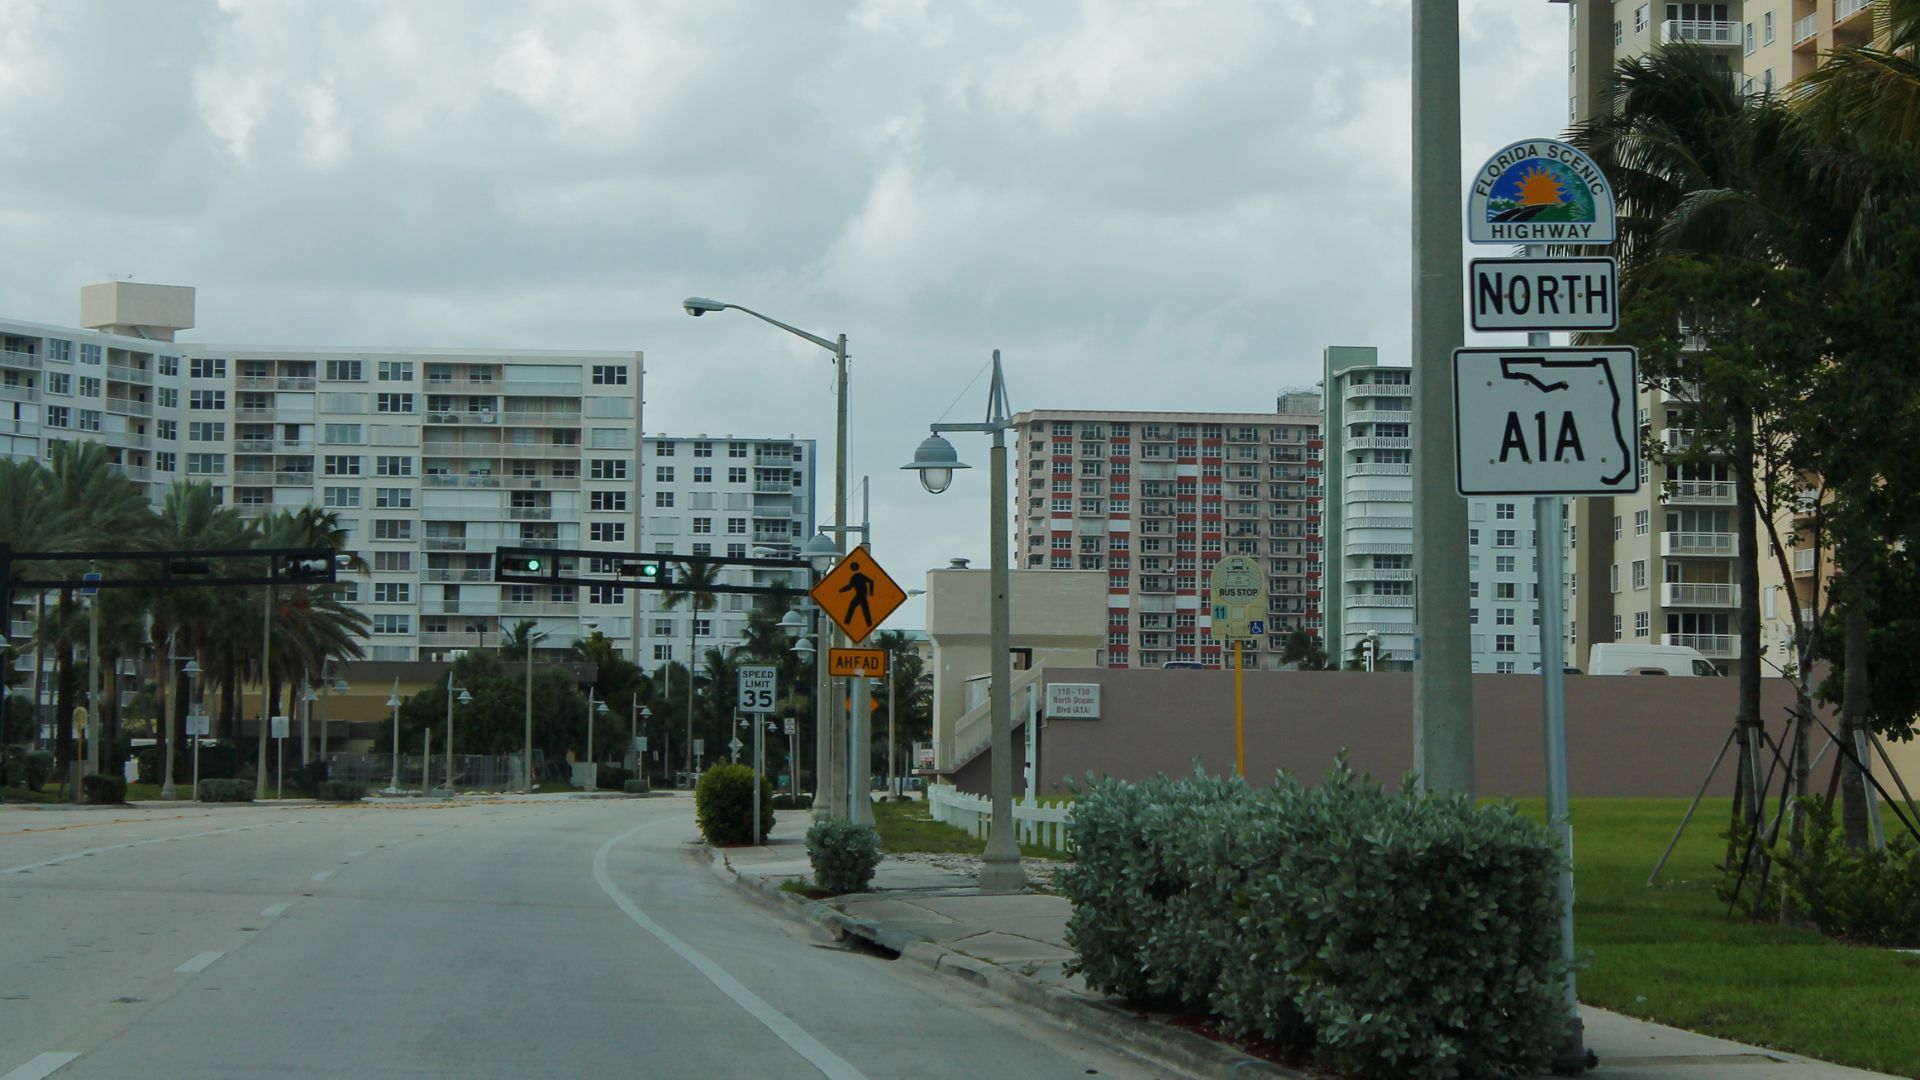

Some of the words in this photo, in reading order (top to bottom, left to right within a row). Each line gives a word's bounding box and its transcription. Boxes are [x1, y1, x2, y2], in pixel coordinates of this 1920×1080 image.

[1475, 144, 1538, 197] FLORIDA
[1547, 144, 1604, 196] SCENIC
[1491, 223, 1592, 239] HIGHWAY
[1478, 272, 1608, 315] NORTH
[1499, 411, 1585, 462] A1A
[1219, 588, 1236, 597] BUS
[1237, 588, 1258, 597] STOP
[1214, 606, 1225, 619] 11
[835, 655, 879, 670] AHEAD
[742, 670, 774, 679] SPEED
[745, 680, 770, 688] LIMIT
[743, 690, 773, 708] 35
[1053, 696, 1072, 704] North
[1072, 696, 1095, 704] Ocean
[1056, 705, 1071, 714] Blvd
